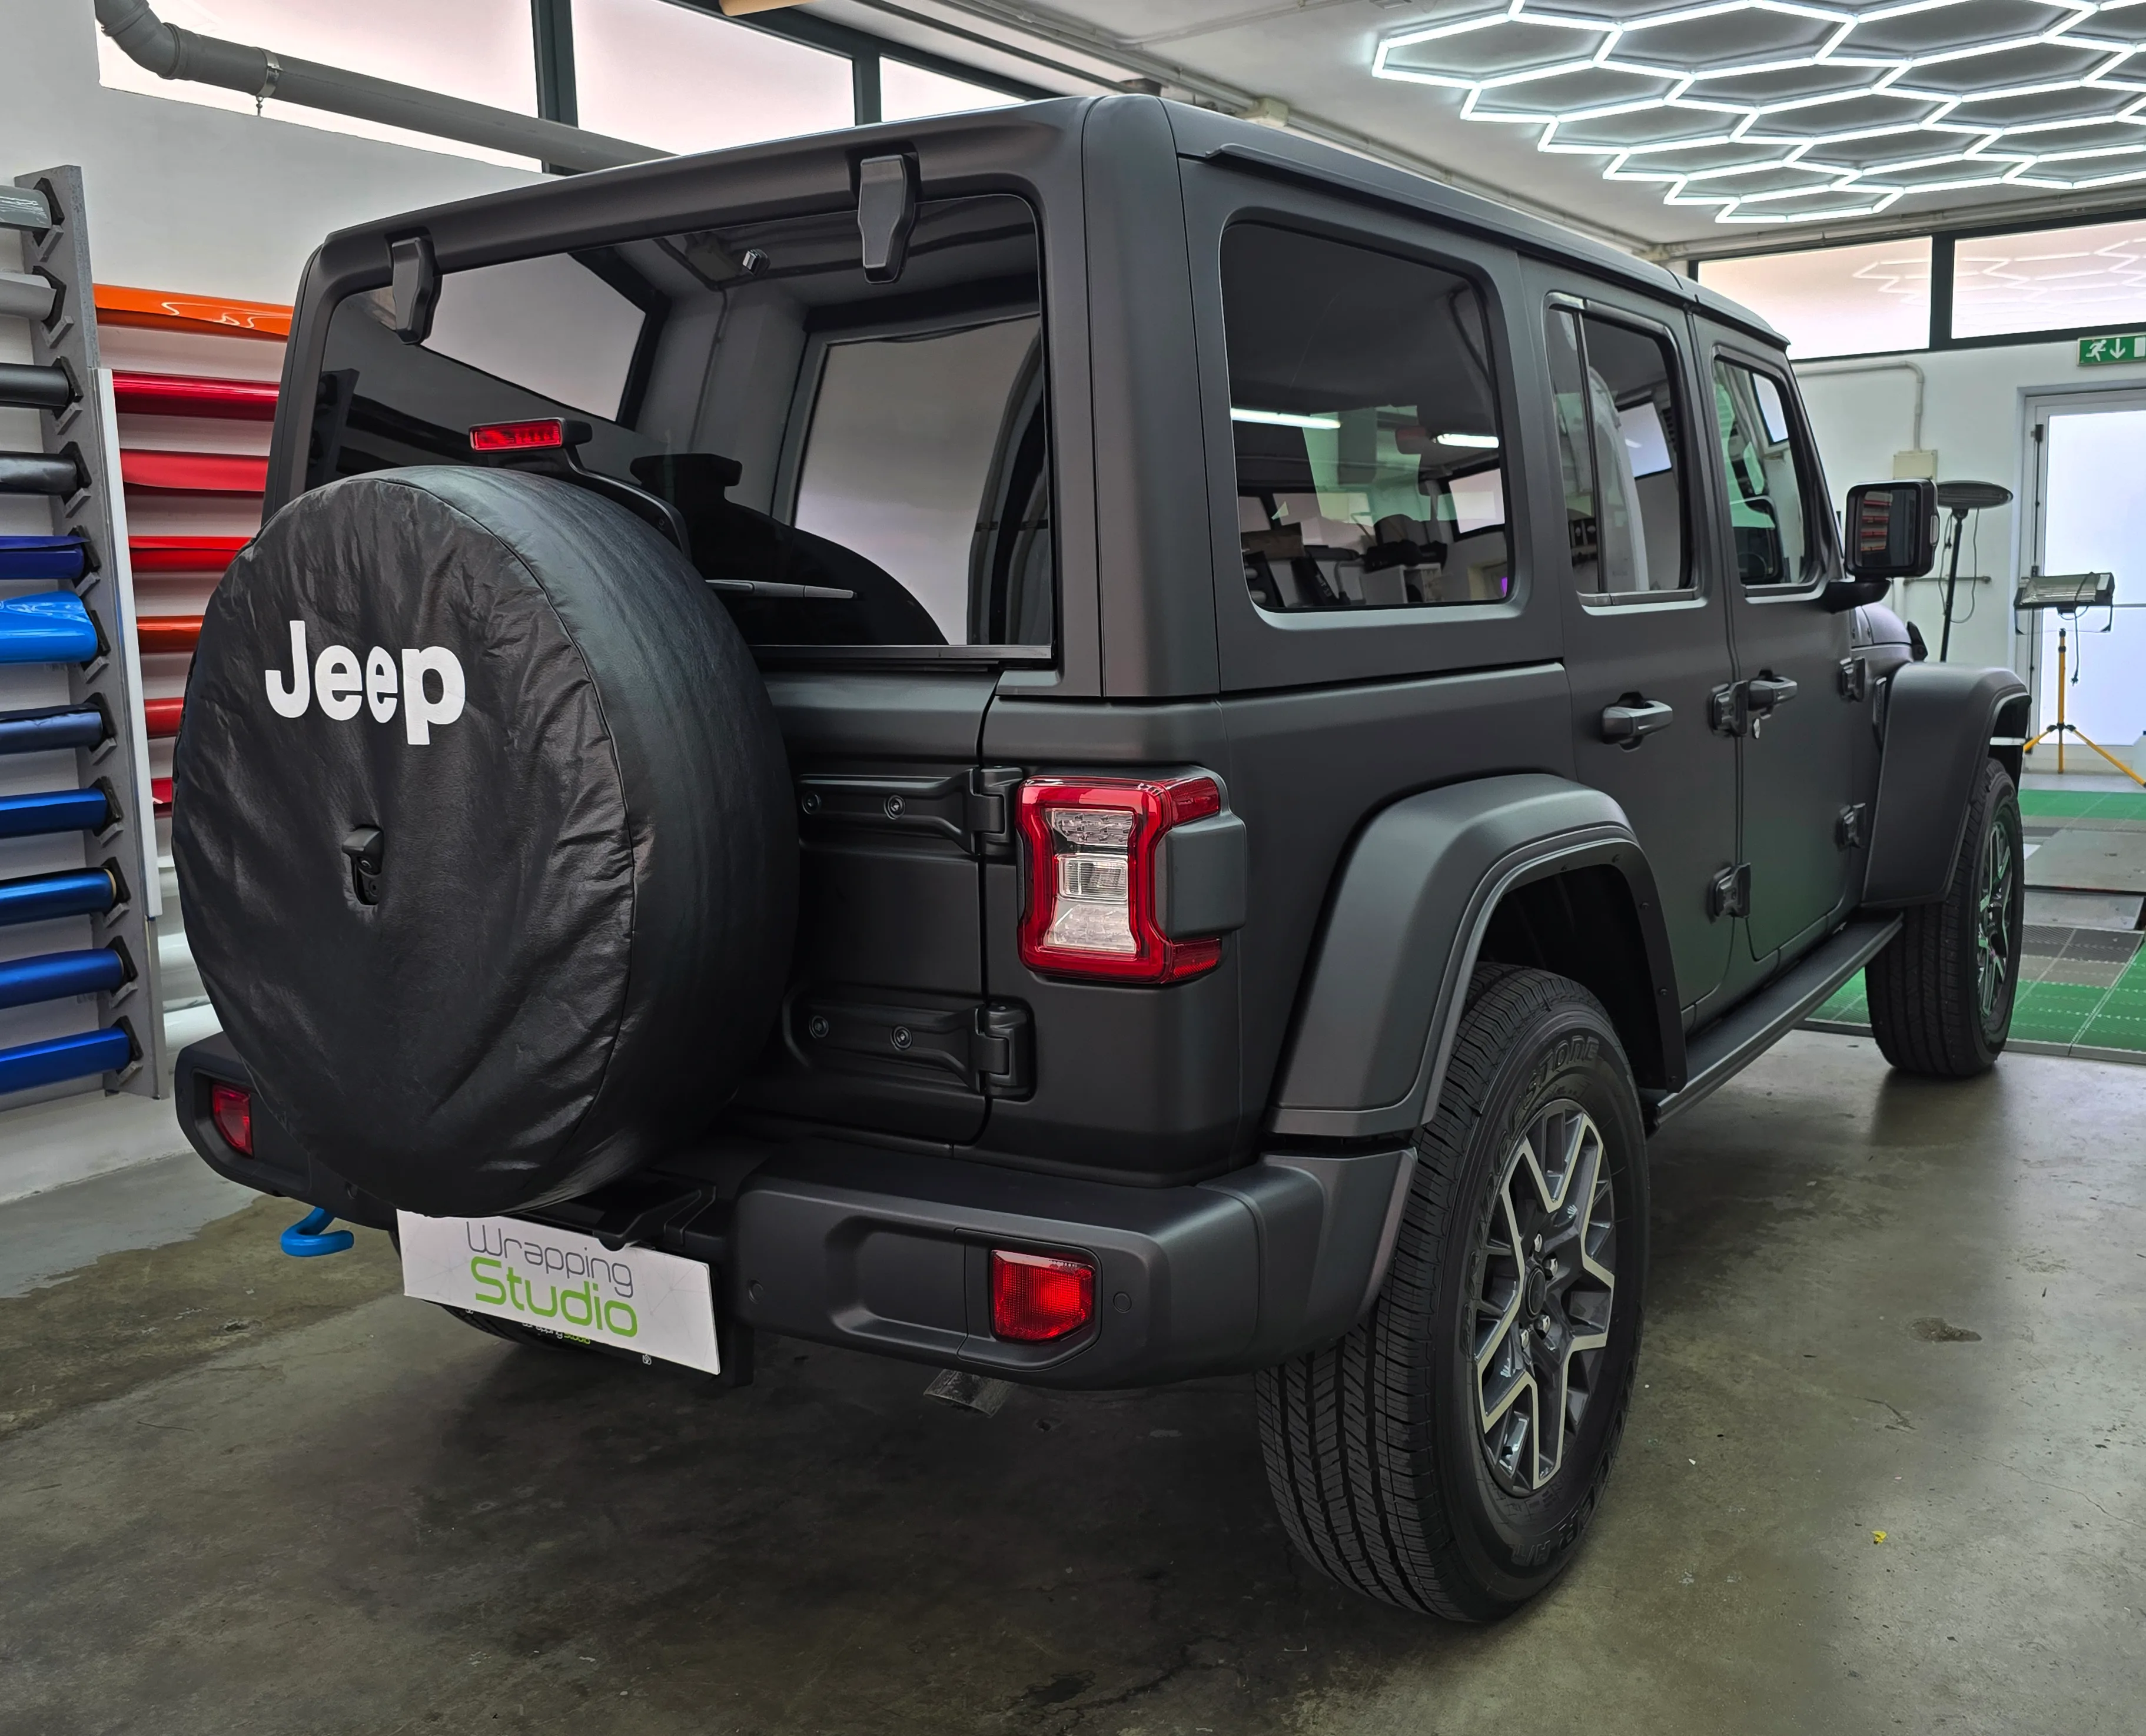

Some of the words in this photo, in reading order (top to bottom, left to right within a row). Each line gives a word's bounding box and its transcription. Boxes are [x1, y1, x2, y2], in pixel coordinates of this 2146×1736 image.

[265, 620, 465, 745] Jeep
[466, 1221, 634, 1299] Wrapping
[471, 1256, 637, 1337] Studio
